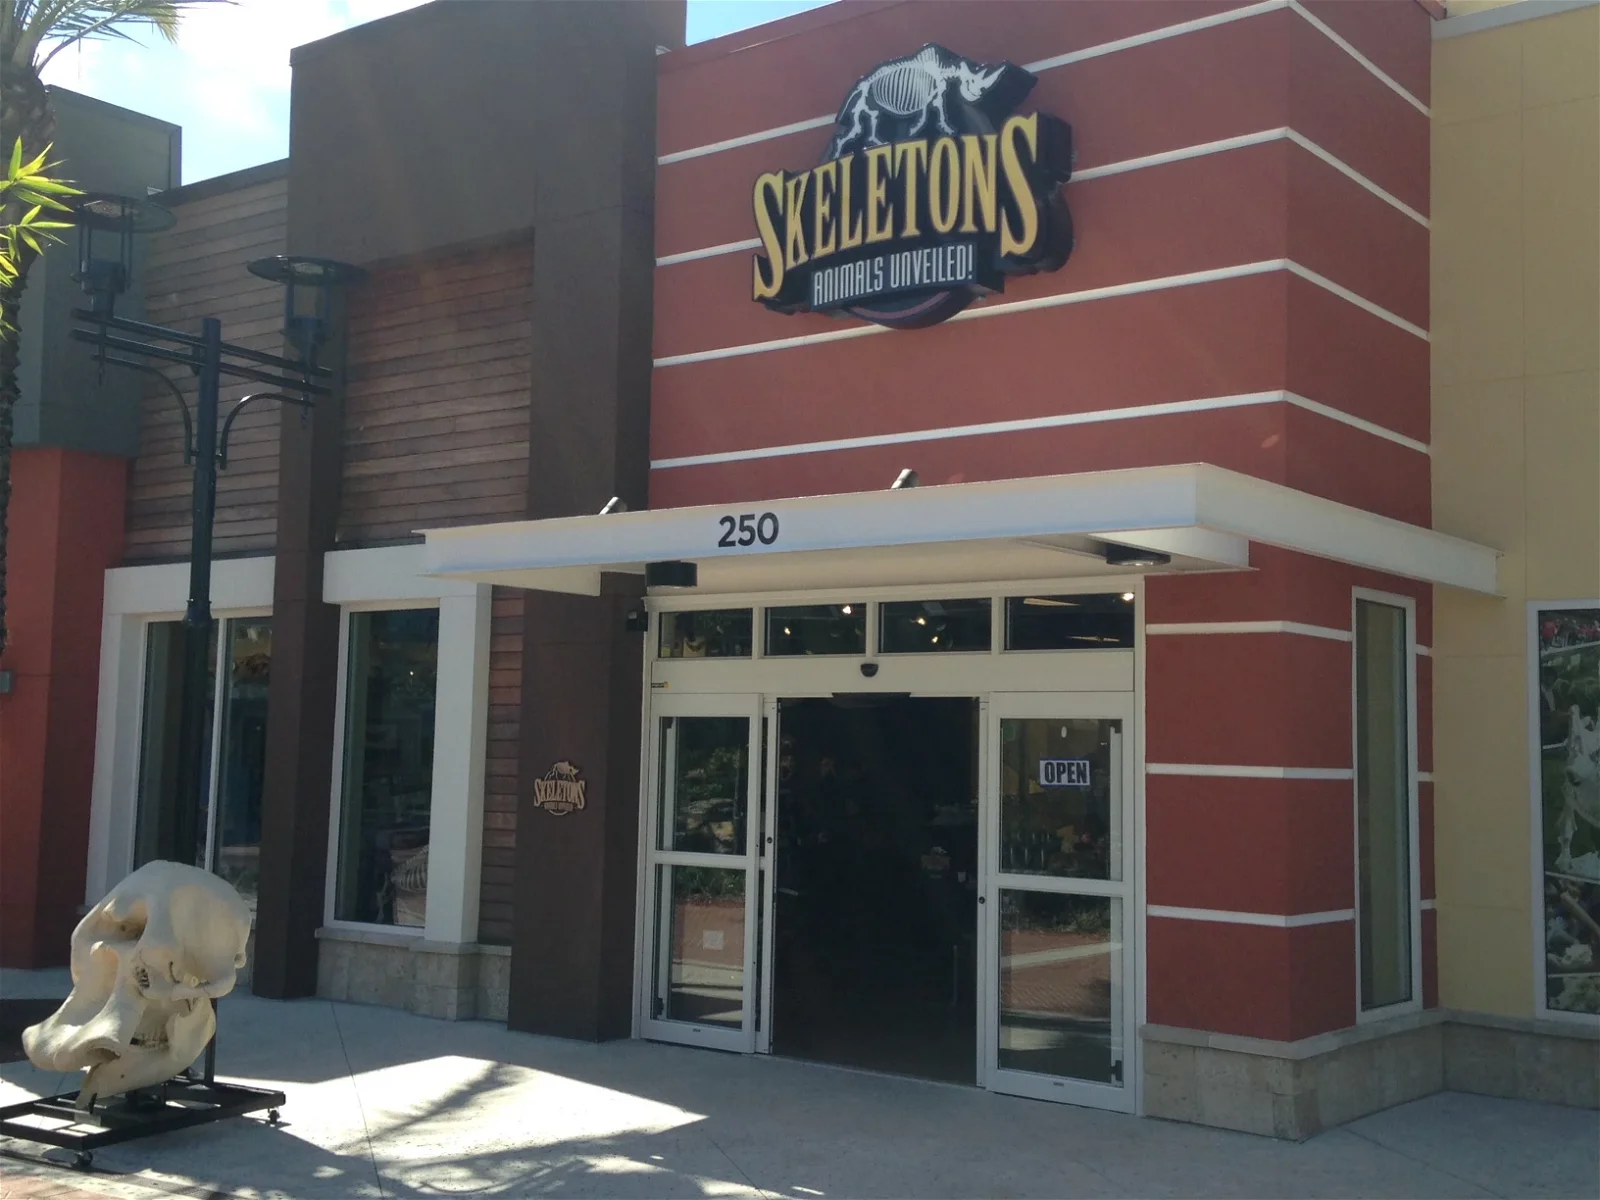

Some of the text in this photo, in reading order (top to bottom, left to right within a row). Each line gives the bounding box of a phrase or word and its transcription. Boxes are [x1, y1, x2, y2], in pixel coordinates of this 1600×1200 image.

[753, 112, 1039, 301] SKELETONS
[813, 244, 973, 305] ANIMALS UNVEILED!
[718, 512, 779, 548] 250
[1044, 761, 1087, 784] OPEN
